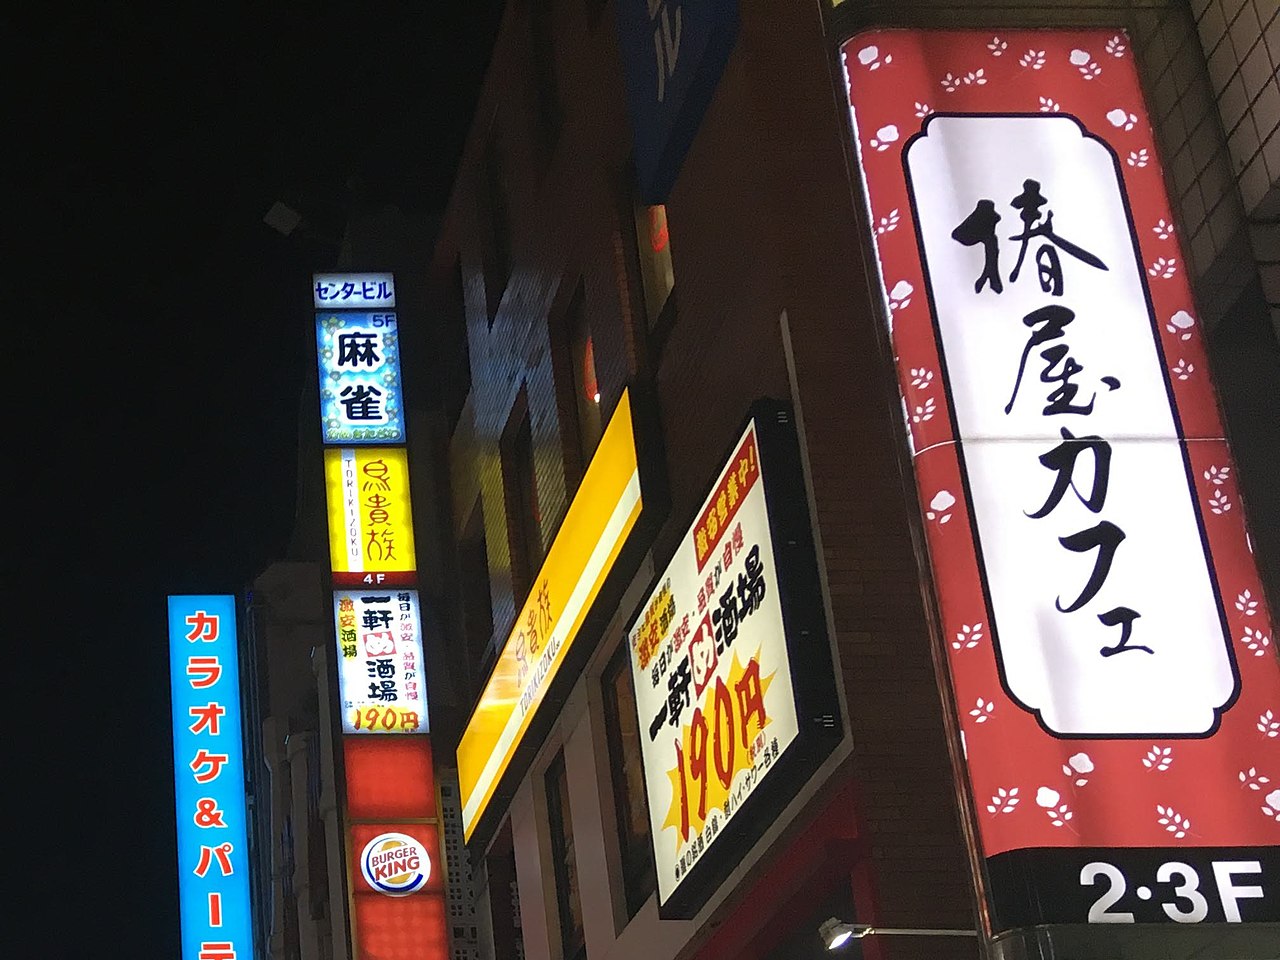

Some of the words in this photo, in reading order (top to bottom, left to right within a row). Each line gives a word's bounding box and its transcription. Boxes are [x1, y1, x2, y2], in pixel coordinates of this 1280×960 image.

[315, 281, 392, 300] センタービル
[372, 315, 396, 328] 5F
[337, 331, 384, 421] 麻雀
[952, 178, 1155, 658] 椿屋カフェ
[363, 574, 385, 584] 4F
[353, 708, 419, 730] 190円
[673, 655, 767, 843] 190円
[371, 847, 417, 867] BURGER
[374, 856, 420, 882] KING
